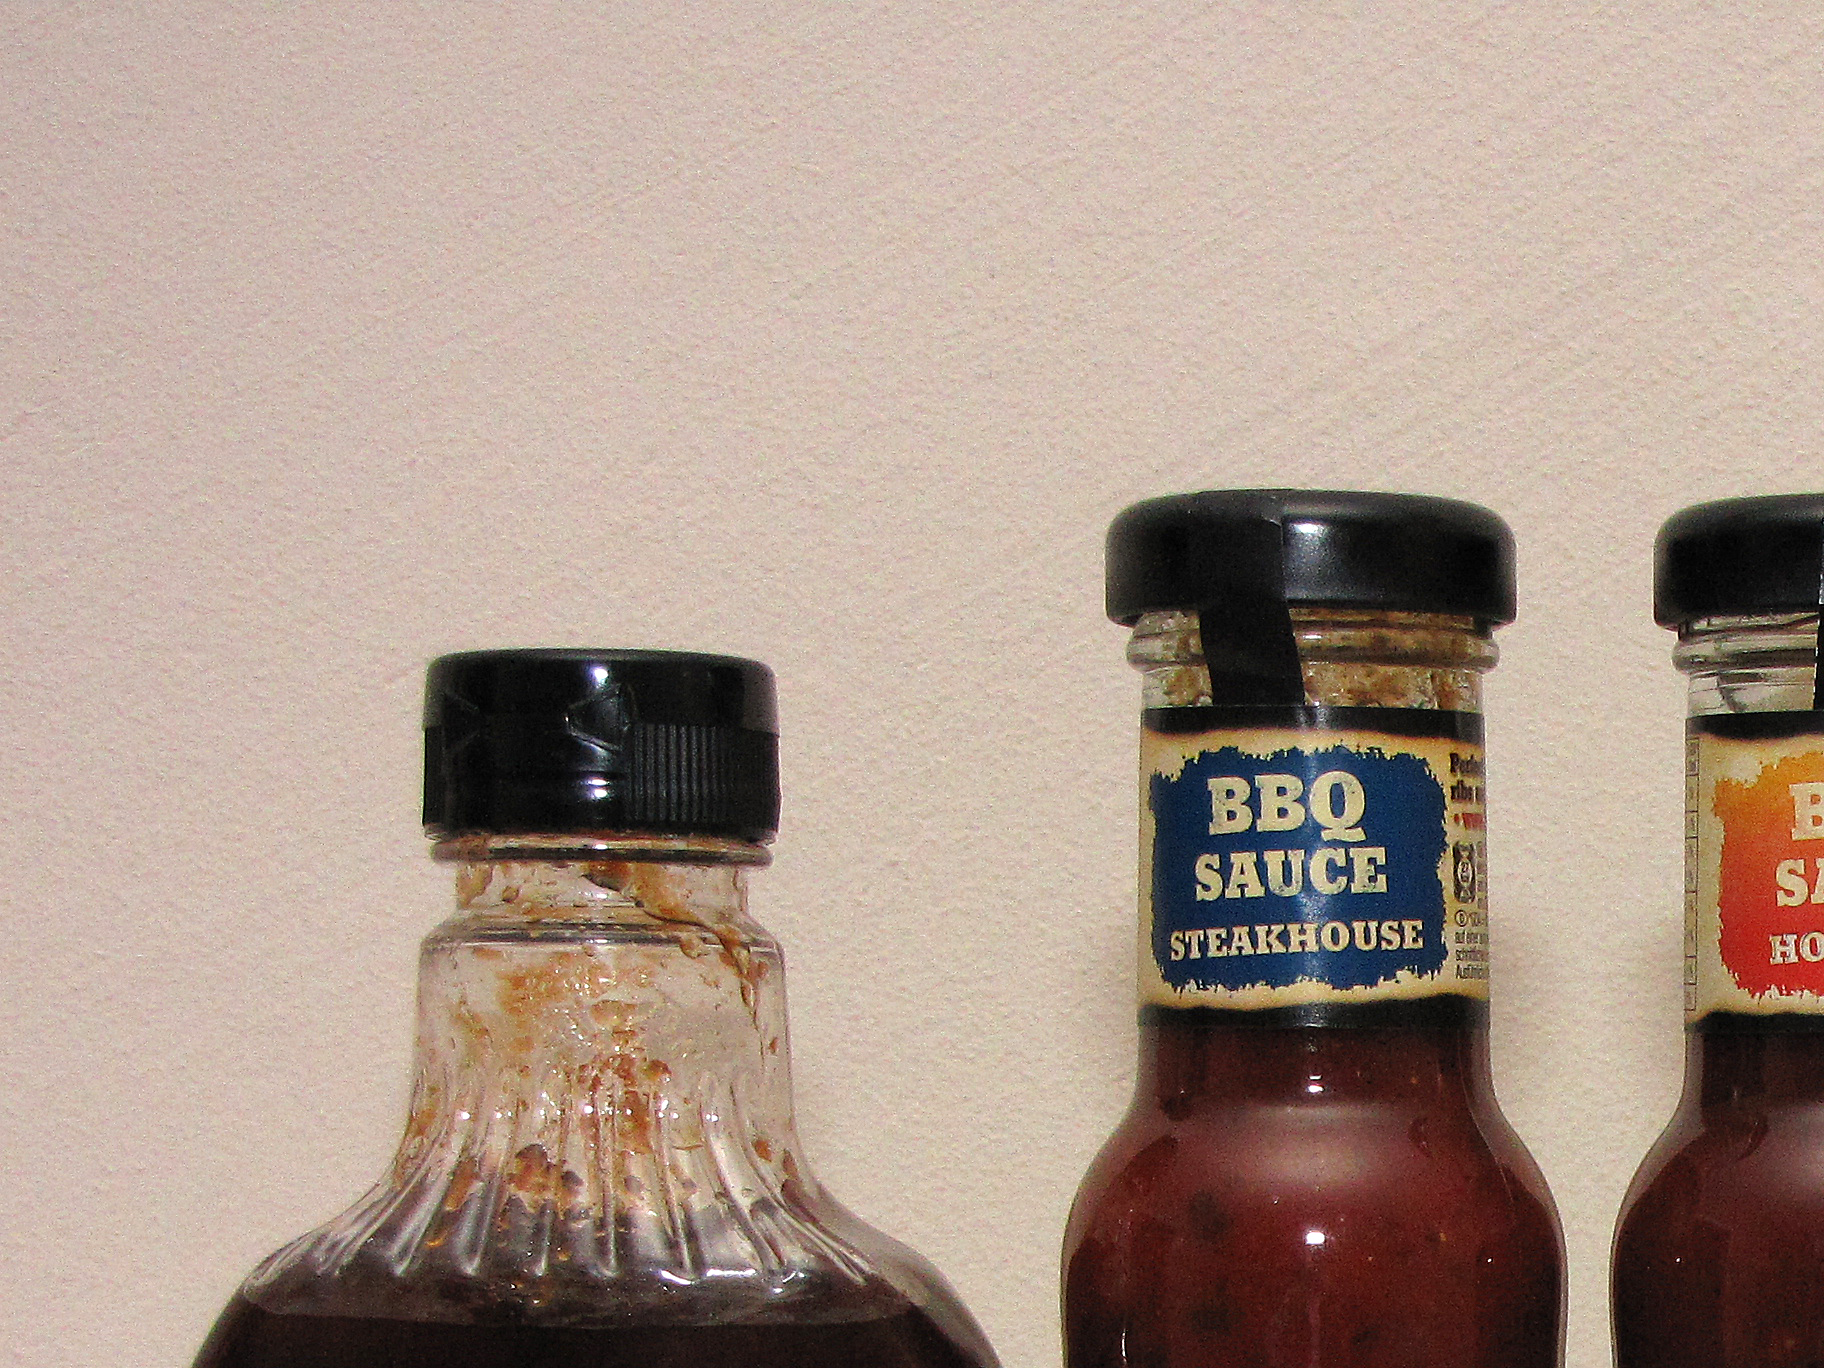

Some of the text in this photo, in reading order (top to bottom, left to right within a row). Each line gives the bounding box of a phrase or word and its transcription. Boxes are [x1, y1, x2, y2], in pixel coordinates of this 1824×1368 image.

[1207, 770, 1366, 842] BBQ
[1194, 847, 1389, 901] SAUCE
[1169, 919, 1424, 961] STEAKHOUSE
